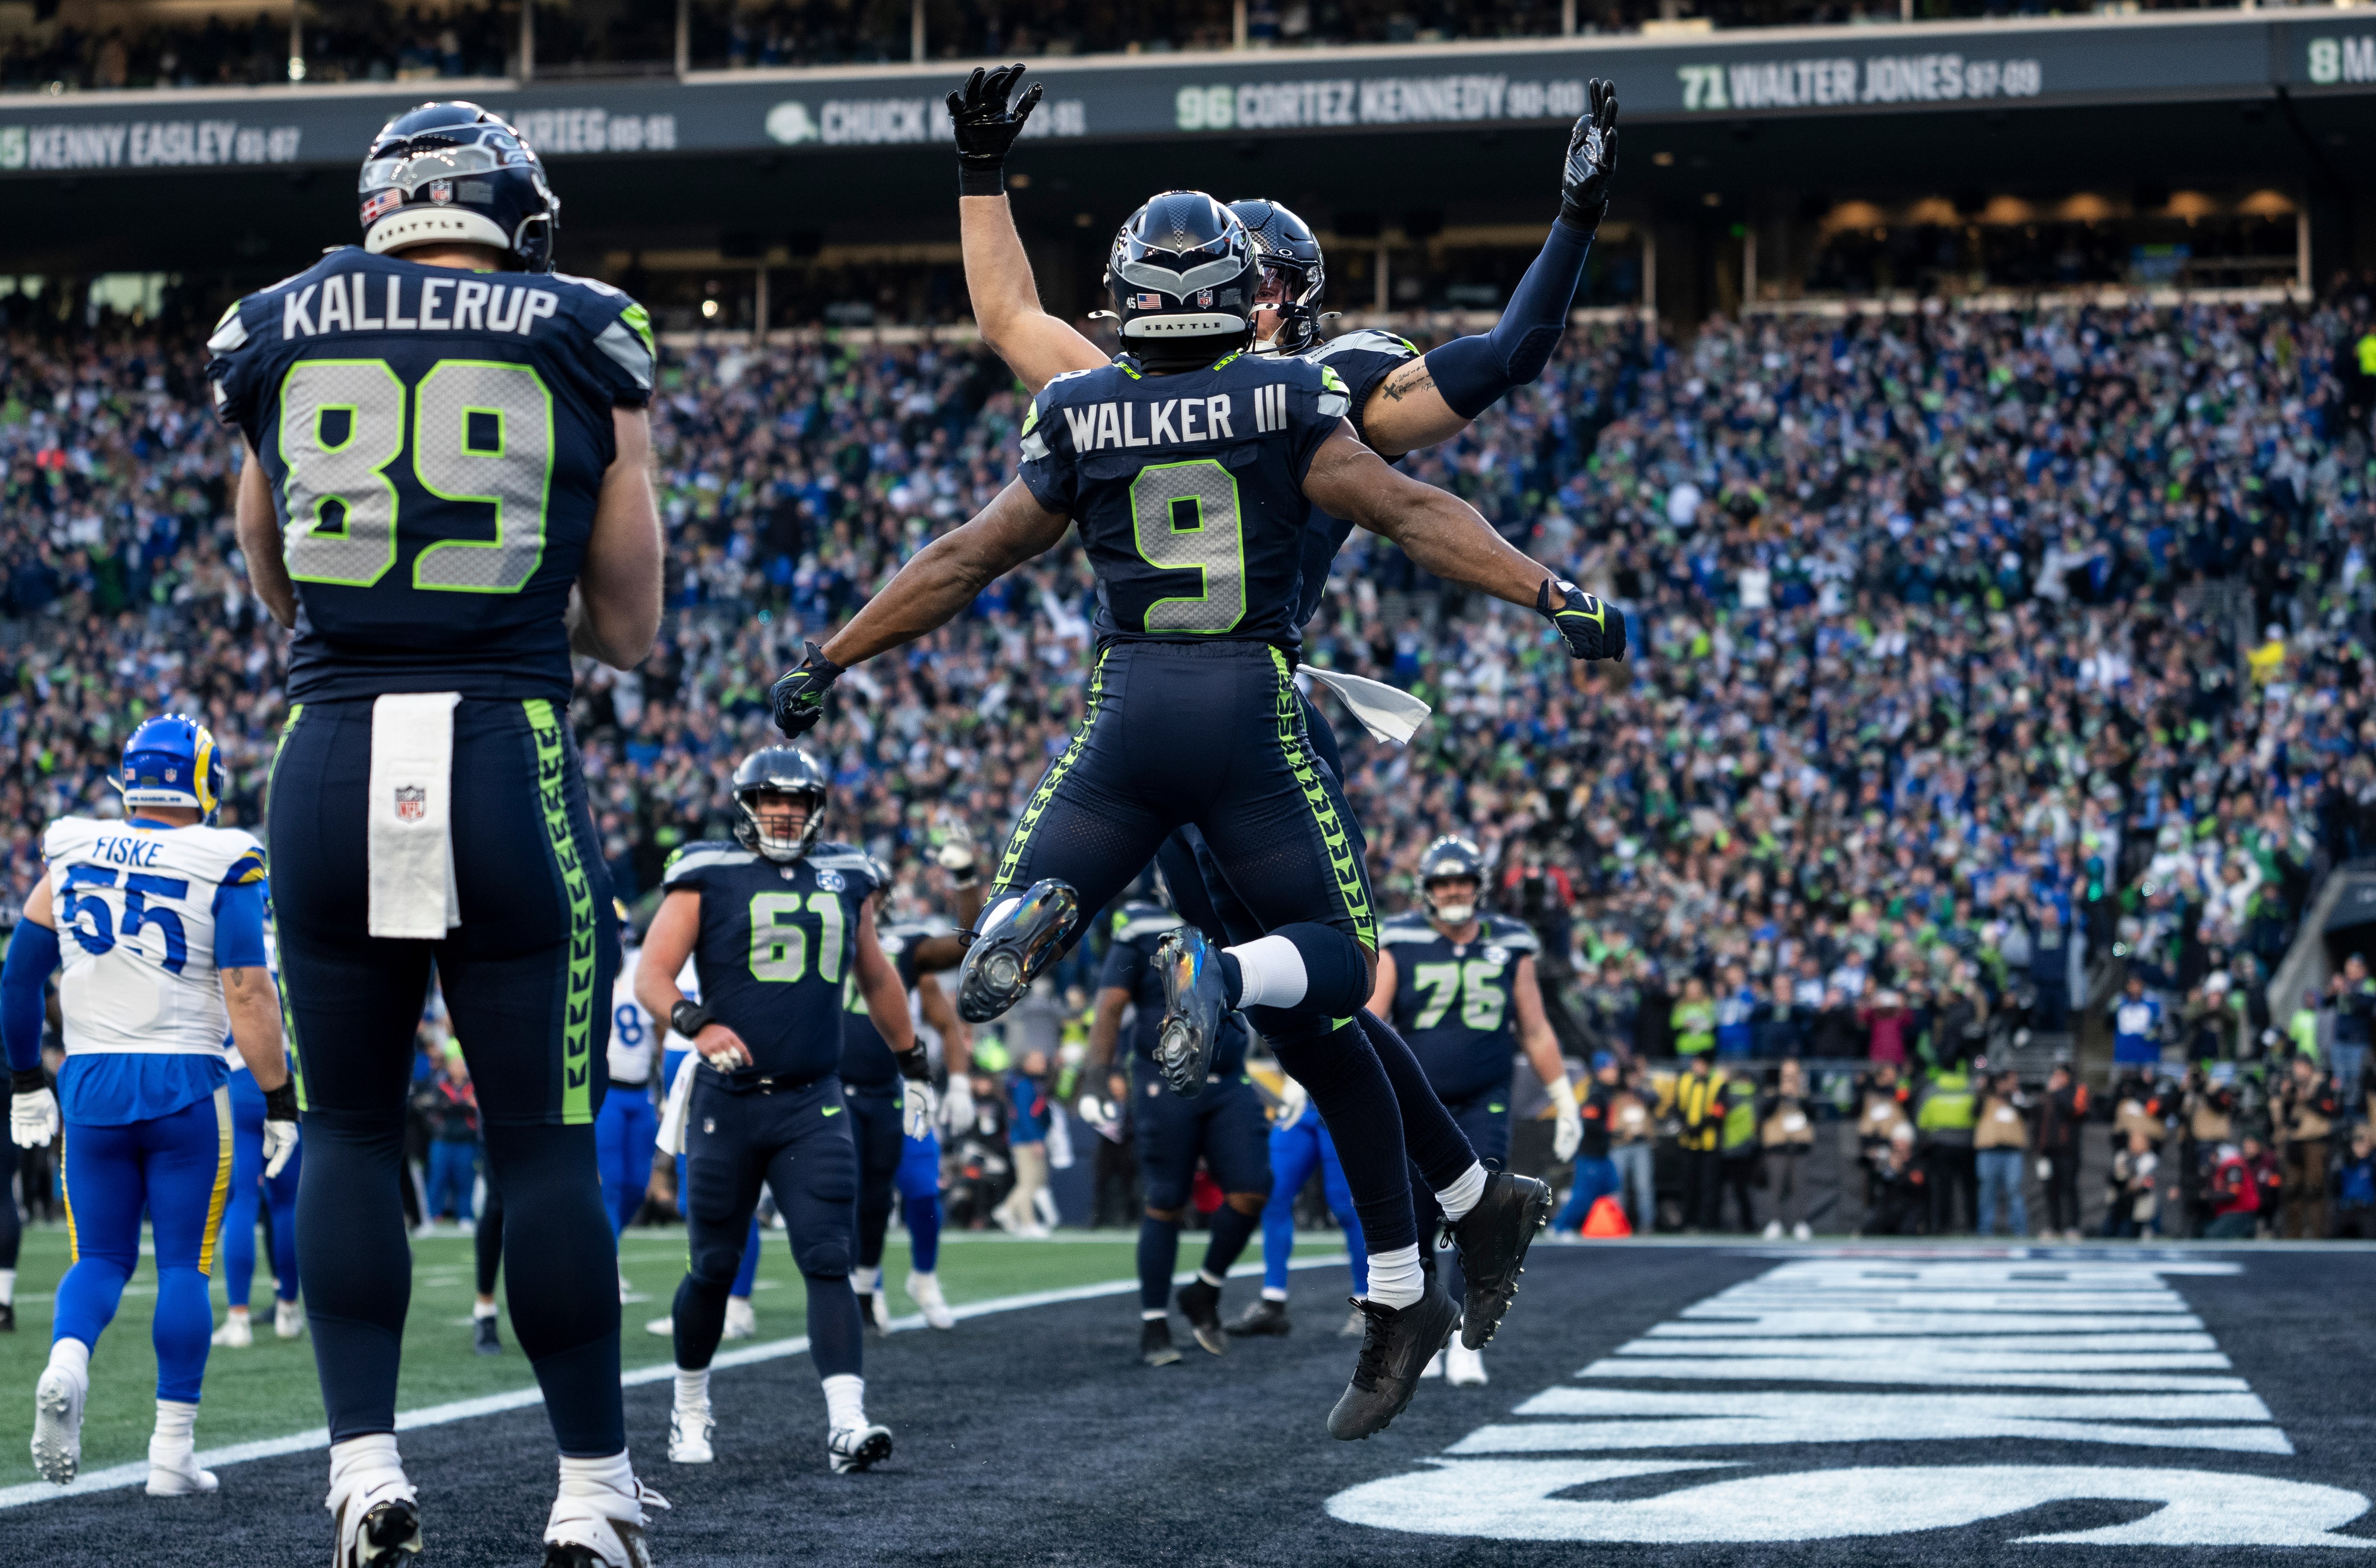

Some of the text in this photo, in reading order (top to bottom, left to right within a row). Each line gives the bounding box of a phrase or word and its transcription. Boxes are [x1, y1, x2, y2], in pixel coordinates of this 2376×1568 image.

[1677, 65, 1728, 110] 71
[1730, 58, 1857, 108] WALTER
[1862, 54, 1964, 104] JONES
[2308, 38, 2340, 84] 8
[821, 98, 925, 145] CHUCK
[1176, 87, 1233, 130] 96
[1237, 80, 1355, 129] CORTEZ
[1360, 74, 1508, 123] KENNEDY
[29, 125, 127, 169] KENNY
[130, 121, 236, 167] EASLEY
[378, 220, 464, 241] SEATTLE
[283, 272, 558, 340] KALLERUP
[1126, 297, 1136, 309] 45
[1145, 322, 1221, 330] SEATTLE
[1063, 384, 1287, 453] WALKER III
[279, 358, 554, 593] 89
[1129, 459, 1246, 634] 9
[92, 836, 164, 867] FISKE
[749, 892, 844, 983] 61
[1414, 958, 1506, 1031] 76
[614, 1001, 643, 1048] 8
